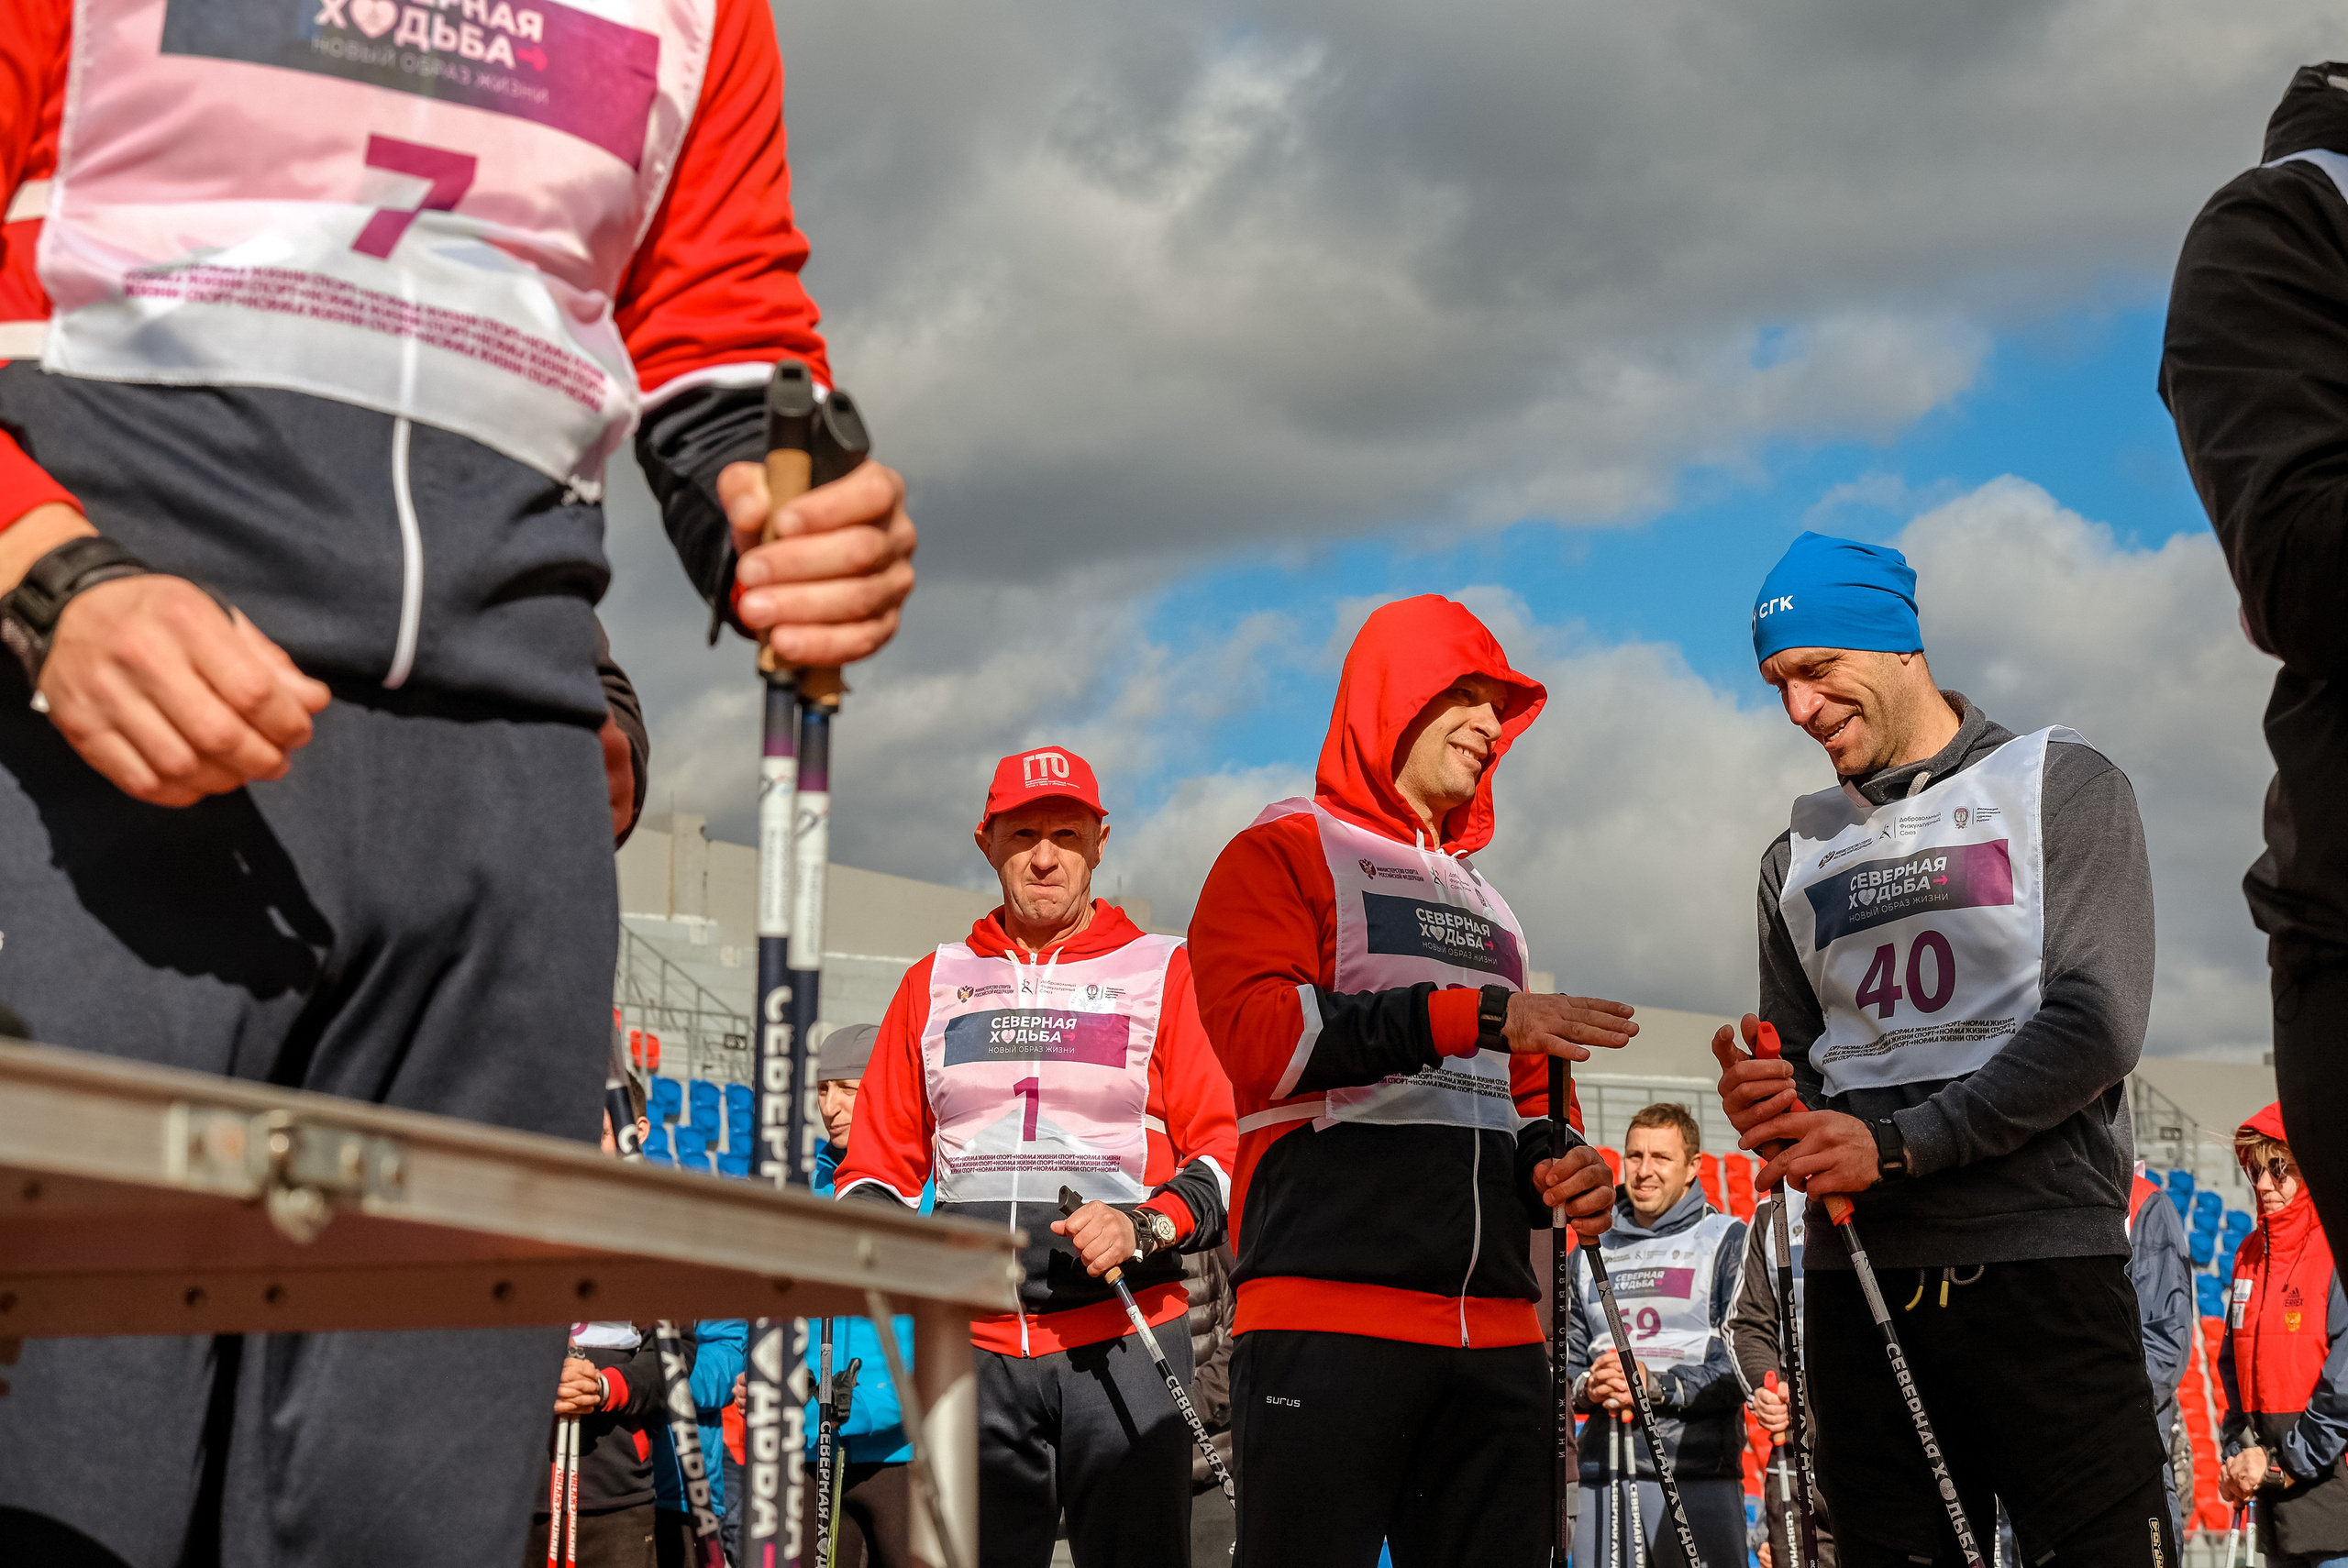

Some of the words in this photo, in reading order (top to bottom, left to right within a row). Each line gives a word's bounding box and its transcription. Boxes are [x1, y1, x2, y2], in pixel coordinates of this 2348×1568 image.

[351, 133, 478, 259] 7
[1759, 595, 1794, 619] СГК
[1023, 752, 1070, 780] ГТО
[1899, 812, 1941, 823] Добровольный
[1850, 856, 1948, 891] СЕВЕРНАЯ
[1415, 908, 1490, 937] СЕВЕРНАЯ
[1849, 903, 1878, 923] НОВЫЙ
[1882, 899, 1911, 914] ОБРАЗ
[1912, 893, 1949, 904] ЖИЗНИ
[1423, 941, 1446, 954] НОВЫЙ
[1448, 948, 1473, 960] ОБРАЗ
[1473, 952, 1497, 965] ЖИЗНИ
[1855, 930, 1955, 1020] 40
[991, 1016, 1077, 1030] СЕВЕРНАЯ
[1013, 1077, 1039, 1141] 1
[1615, 1271, 1665, 1282] СЕВЕРНАЯ
[1266, 1396, 1301, 1408] surus
[1886, 1342, 1940, 1458] СЕВЕРНАЯ
[1165, 1375, 1218, 1466] СЕВЕРНАЯ
[818, 1421, 832, 1520] СЕВЕРНАЯ
[1629, 1483, 1642, 1543] СЕВЕРНАЯ
